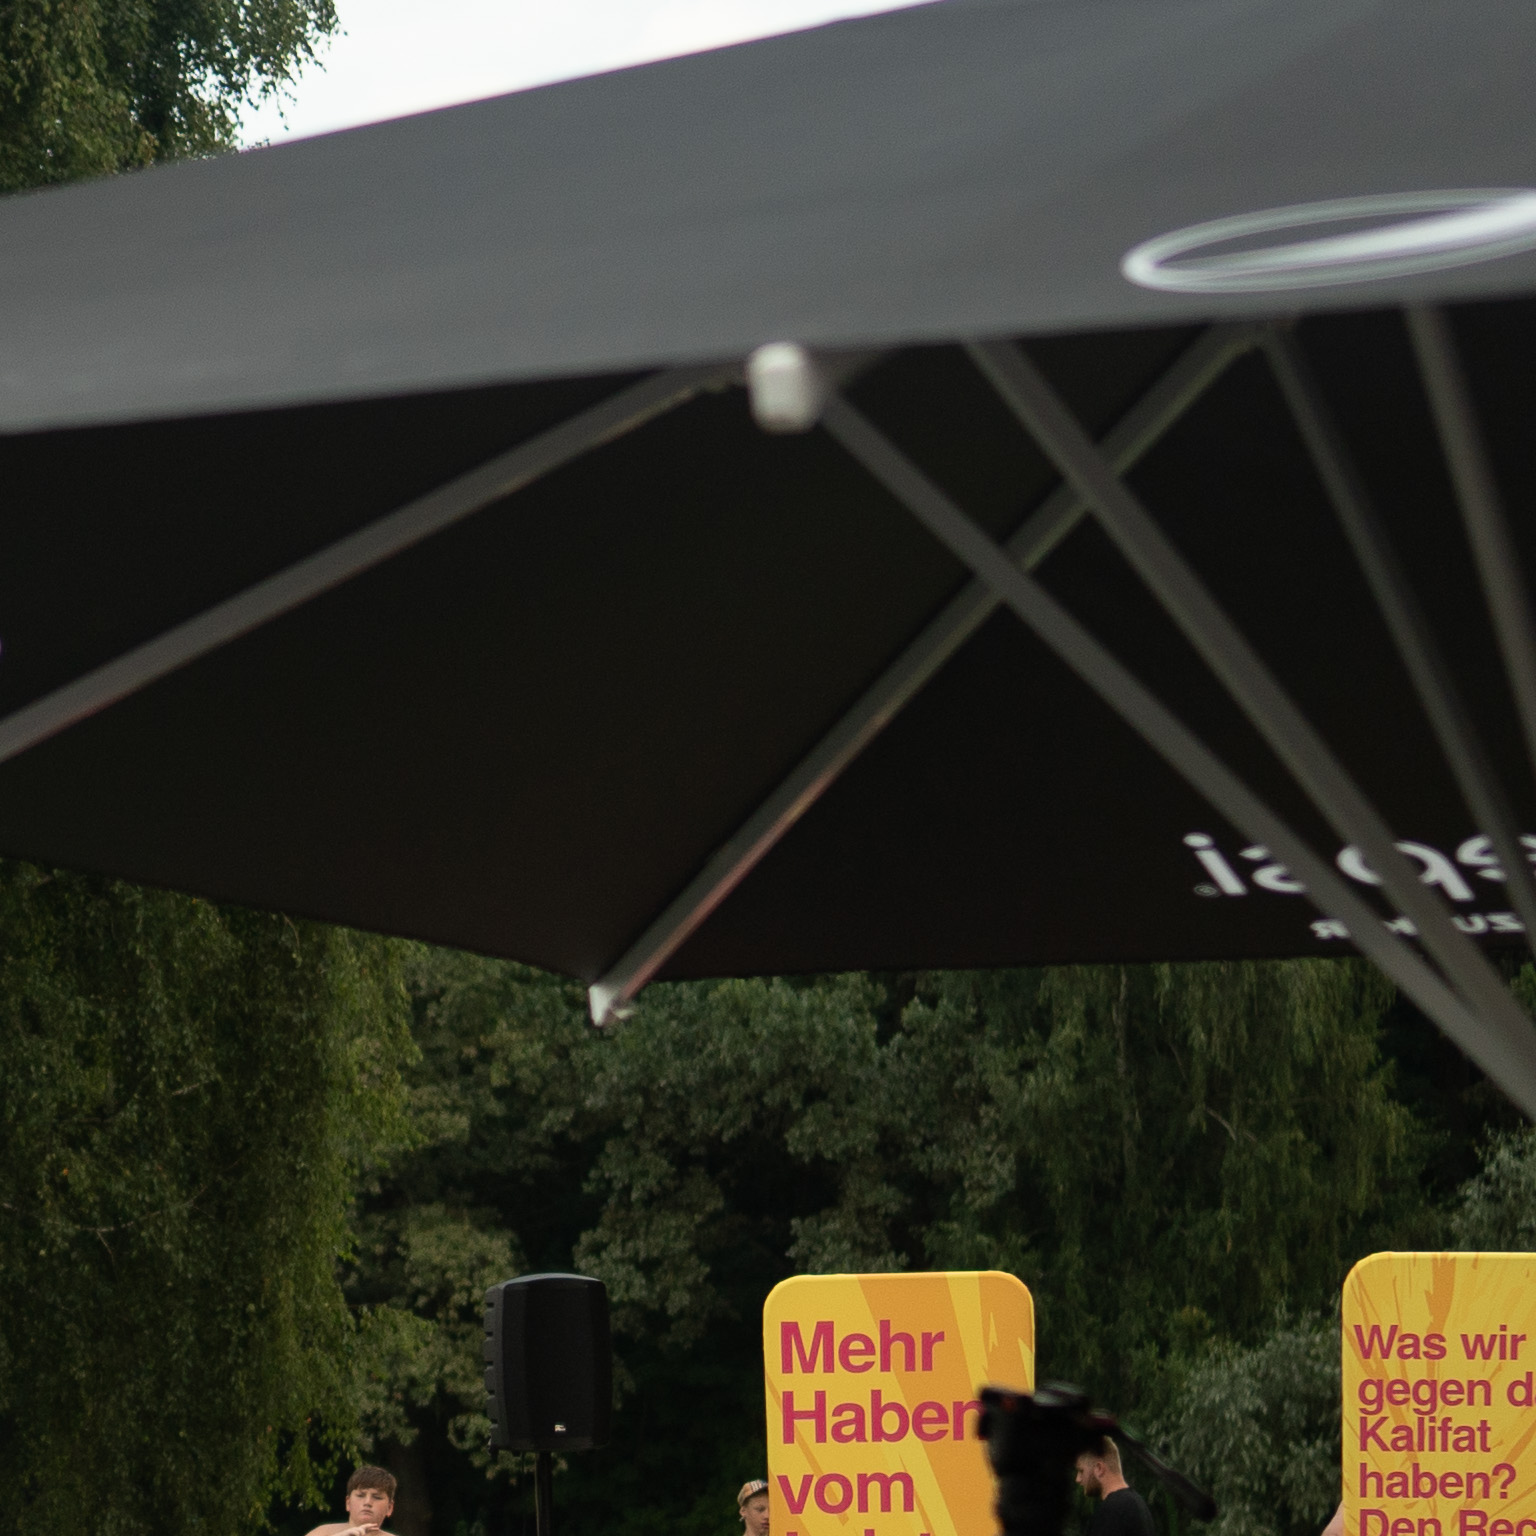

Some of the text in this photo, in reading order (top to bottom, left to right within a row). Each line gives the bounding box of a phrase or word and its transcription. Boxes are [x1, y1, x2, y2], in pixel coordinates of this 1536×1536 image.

[779, 1320, 945, 1374] Mehr
[1353, 1324, 1526, 1360] Was wir
[1358, 1378, 1492, 1416] gegen
[783, 1391, 988, 1443] Haben
[1359, 1416, 1491, 1452] Kalifat
[777, 1472, 914, 1514] vom
[1359, 1462, 1517, 1499] haben?
